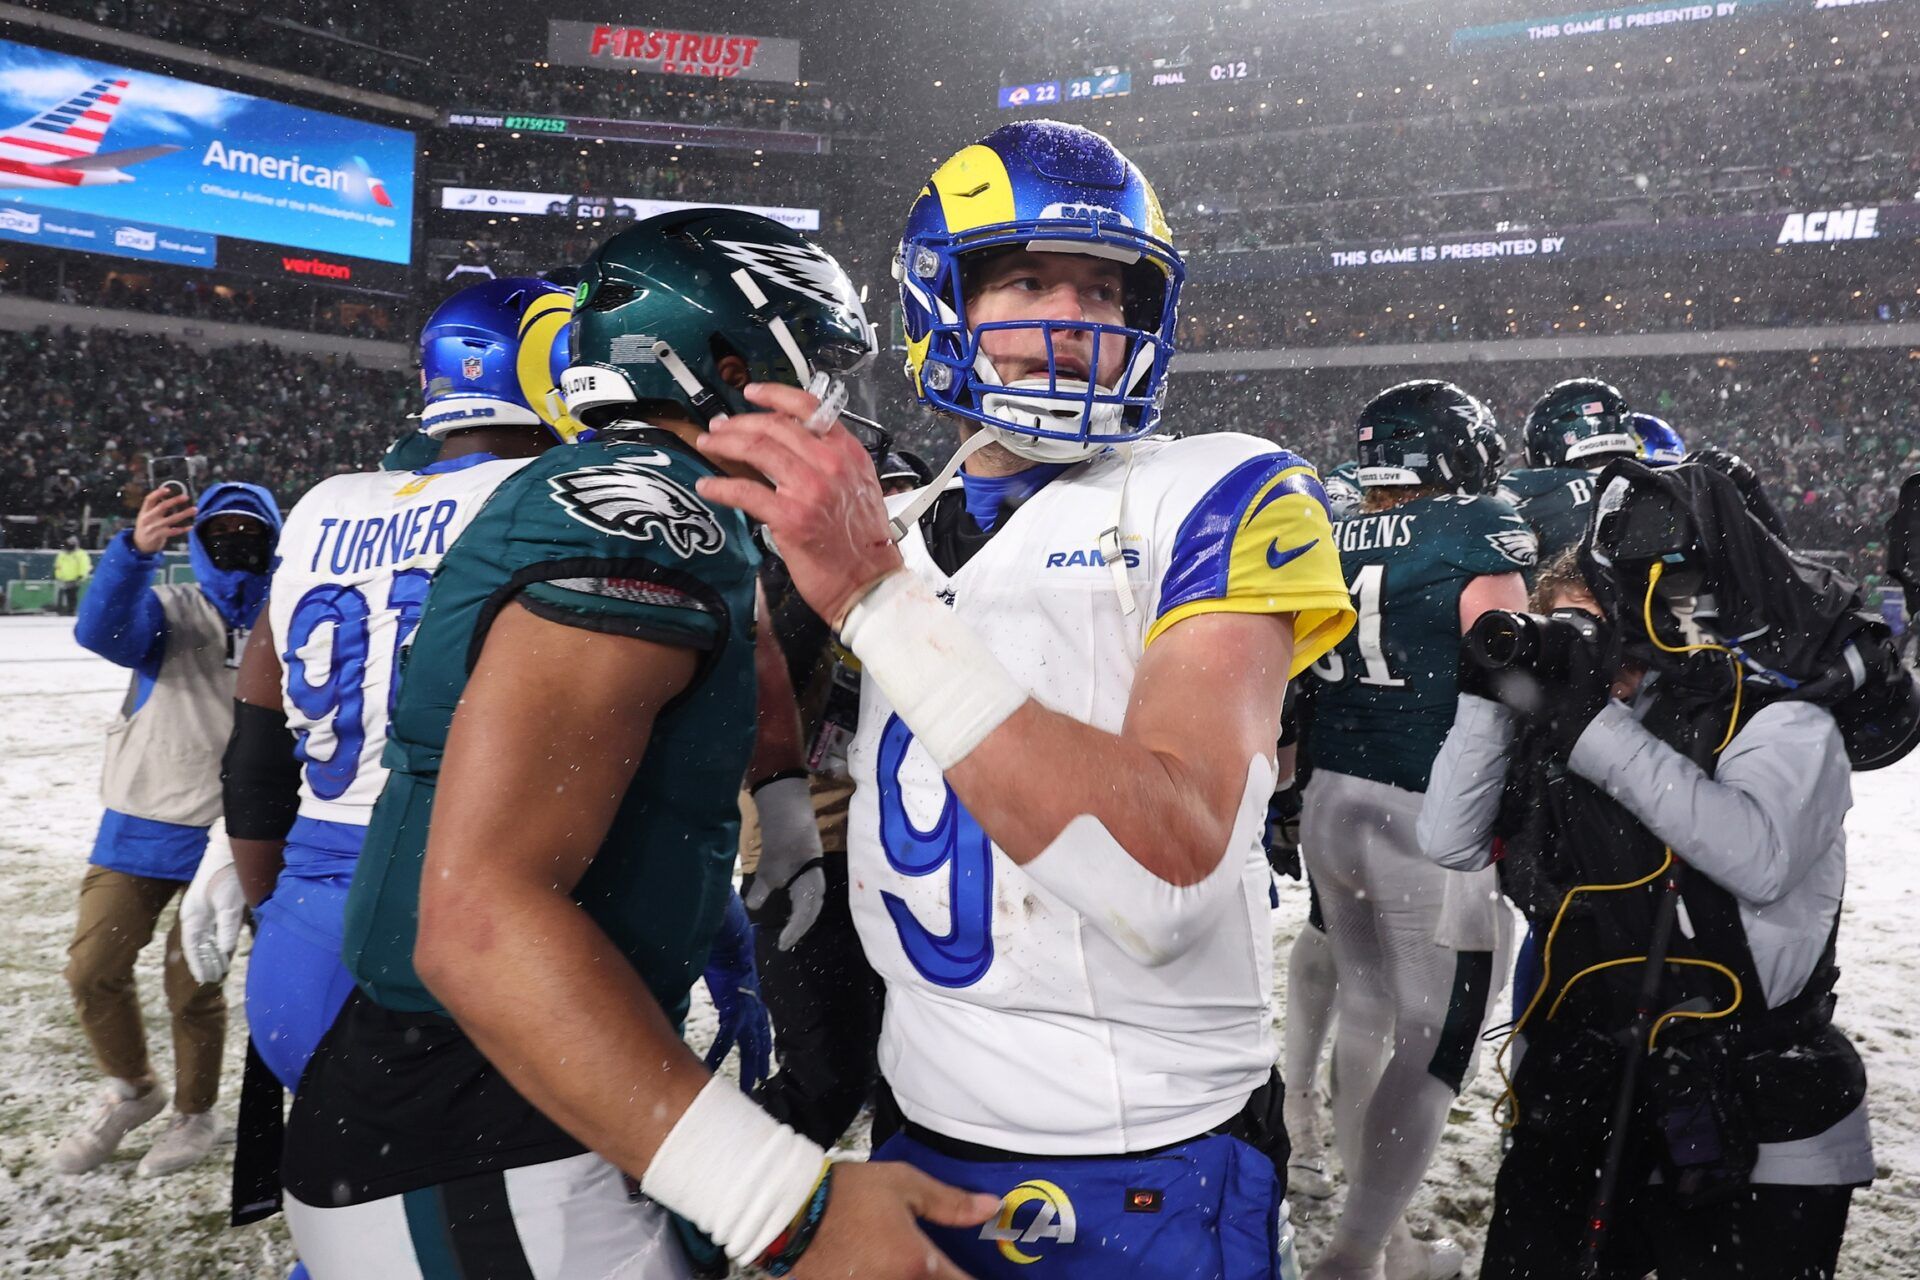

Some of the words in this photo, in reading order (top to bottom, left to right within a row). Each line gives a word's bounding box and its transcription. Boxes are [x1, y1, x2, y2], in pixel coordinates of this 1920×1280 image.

[1528, 25, 1560, 39] THIS
[1563, 19, 1605, 36] GAME
[1608, 16, 1623, 30] IS
[1626, 5, 1713, 27] PRESENTED
[1716, 2, 1738, 16] BY
[1152, 72, 1187, 86] FINAL
[1209, 62, 1248, 80] 0:12
[1036, 86, 1055, 101] 22
[1070, 81, 1091, 97] 28
[202, 140, 350, 193] American
[1777, 208, 1879, 244] ACME
[1331, 252, 1367, 266] THIS
[1370, 247, 1417, 264] GAME
[1421, 246, 1438, 260] IS
[1440, 238, 1537, 259] PRESENTED
[1541, 237, 1565, 253] BY
[282, 257, 351, 279] verizon
[569, 376, 596, 394] LOVE
[1579, 440, 1609, 451] CHOOSE
[311, 500, 457, 575] TURNER
[877, 710, 994, 988] 9
